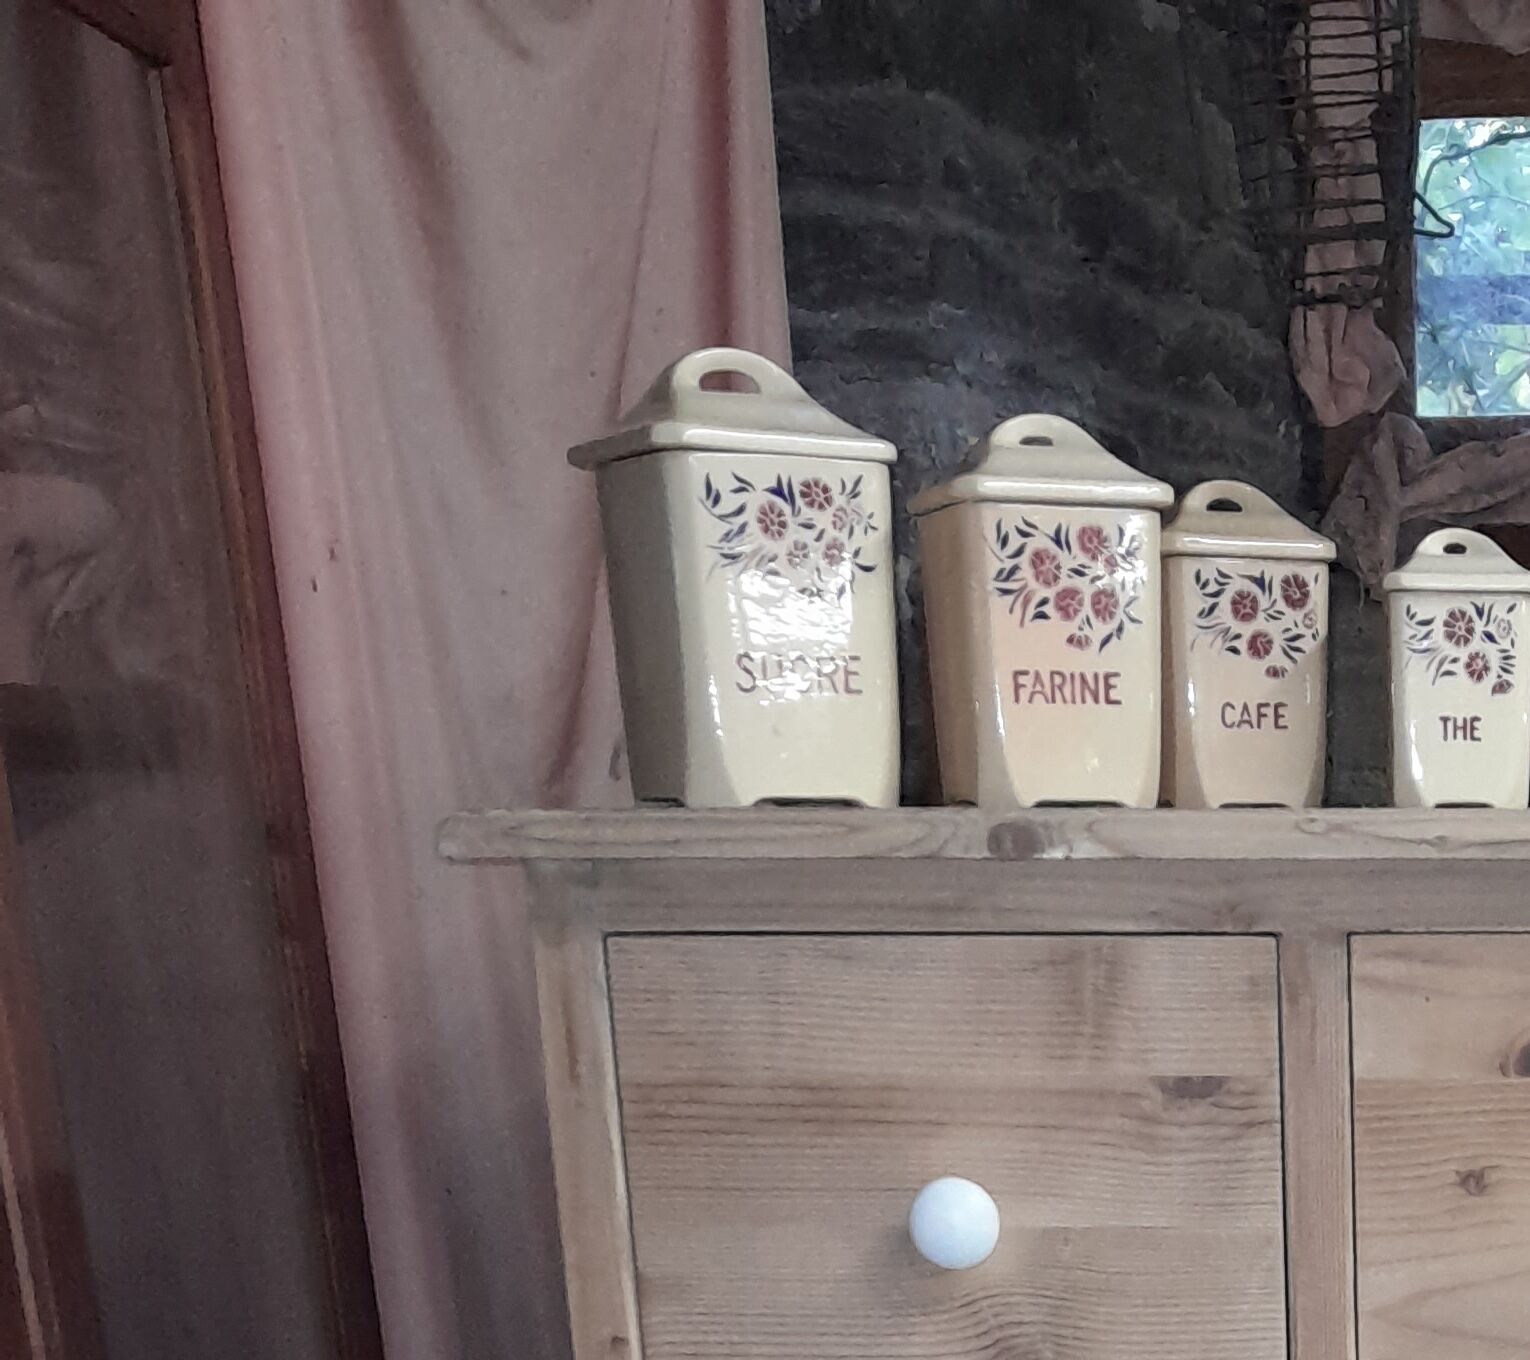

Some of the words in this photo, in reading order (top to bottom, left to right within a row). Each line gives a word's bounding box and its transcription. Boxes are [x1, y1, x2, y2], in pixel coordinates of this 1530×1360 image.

[1012, 670, 1122, 705] FARINE
[1221, 701, 1289, 730] CAFE
[1439, 715, 1482, 742] THE
